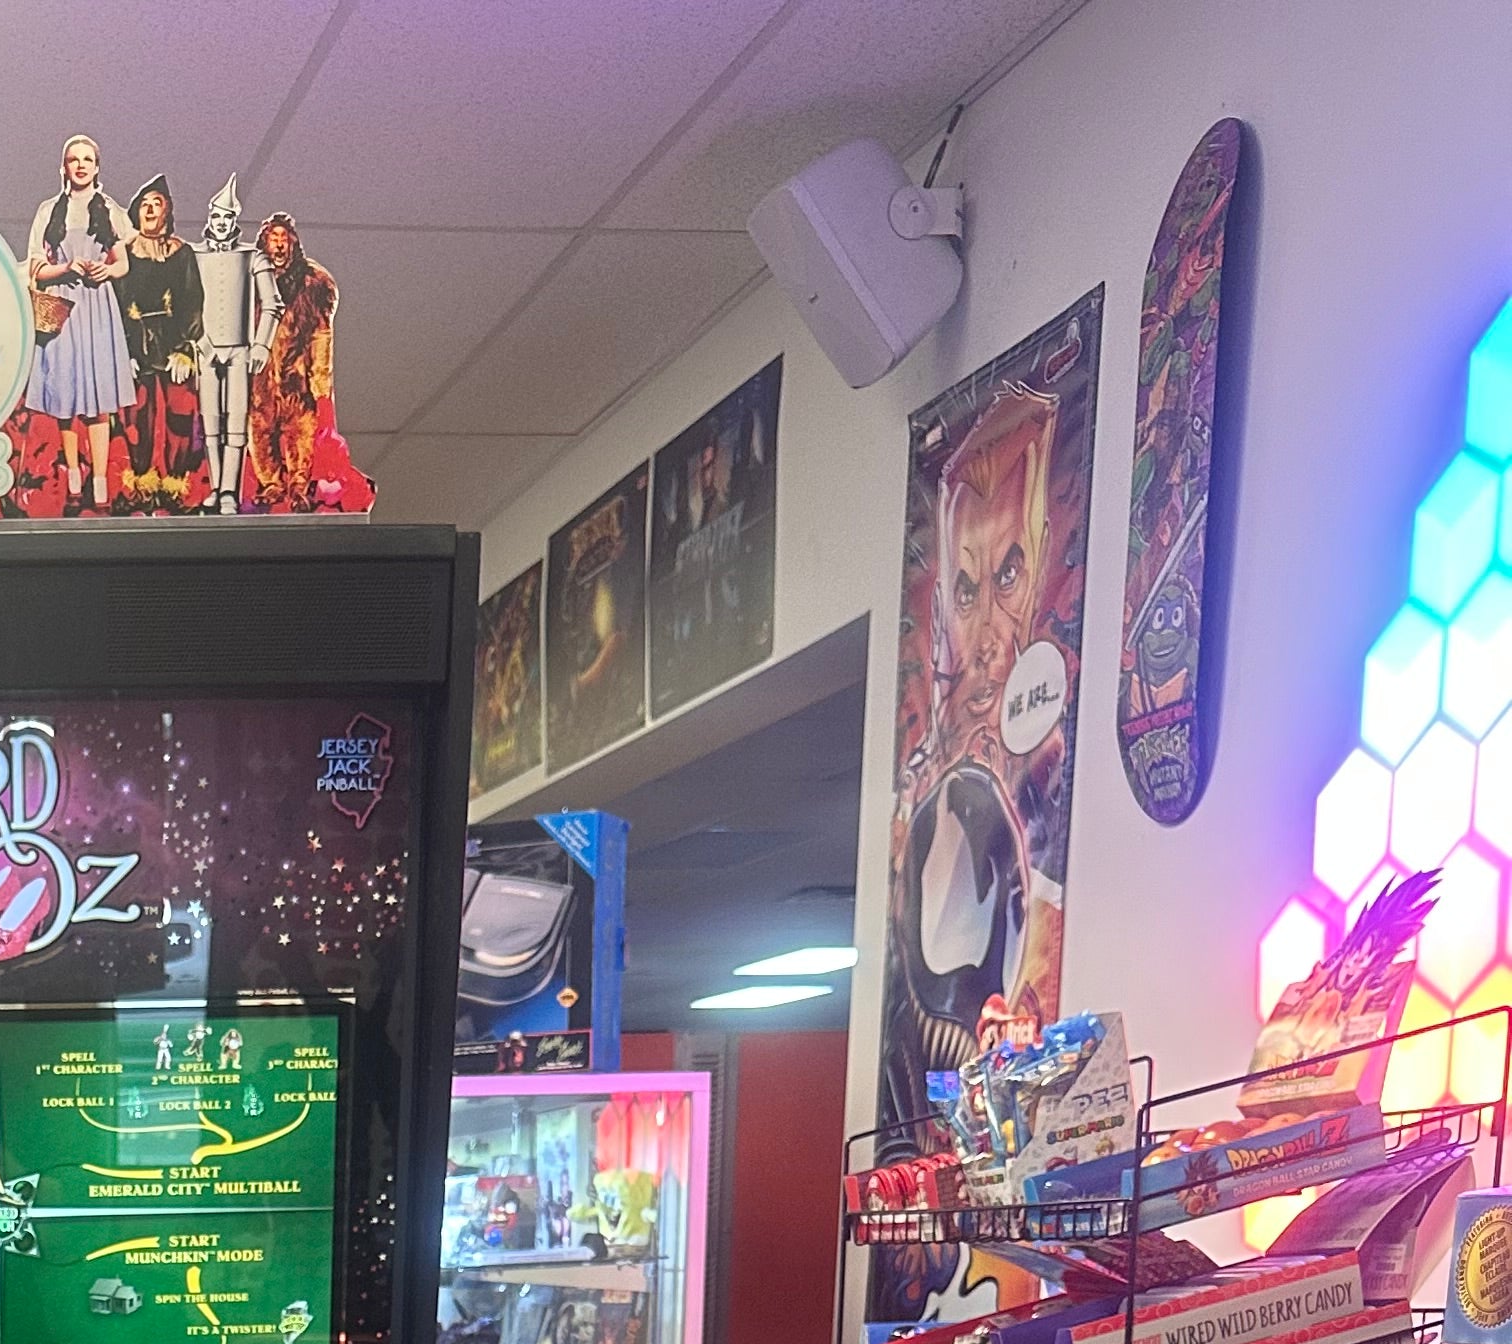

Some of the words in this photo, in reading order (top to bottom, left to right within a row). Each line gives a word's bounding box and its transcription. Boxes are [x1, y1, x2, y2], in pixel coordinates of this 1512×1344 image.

[316, 738, 379, 758] JERSEY
[323, 759, 371, 779] JACK
[316, 777, 377, 792] PINBALL
[61, 1052, 96, 1062] SPELL
[294, 1047, 329, 1057] SPELL
[53, 1063, 123, 1074] CHARACTER
[178, 1063, 213, 1073] SPELL
[170, 1074, 240, 1085] CHARACTER
[43, 1097, 75, 1107] LOCK
[77, 1097, 105, 1107] BALL
[274, 1093, 306, 1103] LOCK
[159, 1101, 191, 1111] LOCK
[193, 1100, 220, 1110] BALL
[222, 1099, 231, 1109] 2
[169, 1166, 221, 1179] START
[1232, 1177, 1273, 1198] DRAGON
[1273, 1169, 1297, 1186] BALL
[1297, 1164, 1321, 1179] STAR
[1322, 1155, 1353, 1174] CANDY
[89, 1184, 163, 1197] EMERALD
[214, 1181, 301, 1194] MULTIBALL
[169, 1235, 220, 1247] START
[125, 1251, 211, 1264] MUNCHKIN
[217, 1250, 264, 1262] MODE
[155, 1294, 181, 1304] SPIN
[183, 1293, 207, 1303] THE
[210, 1293, 249, 1303] HOUSE
[1219, 1309, 1257, 1340] WILD
[1259, 1295, 1303, 1329] BERRY
[1304, 1281, 1354, 1316] CANDY
[211, 1325, 221, 1335] A
[223, 1324, 276, 1335] TWISTER!
